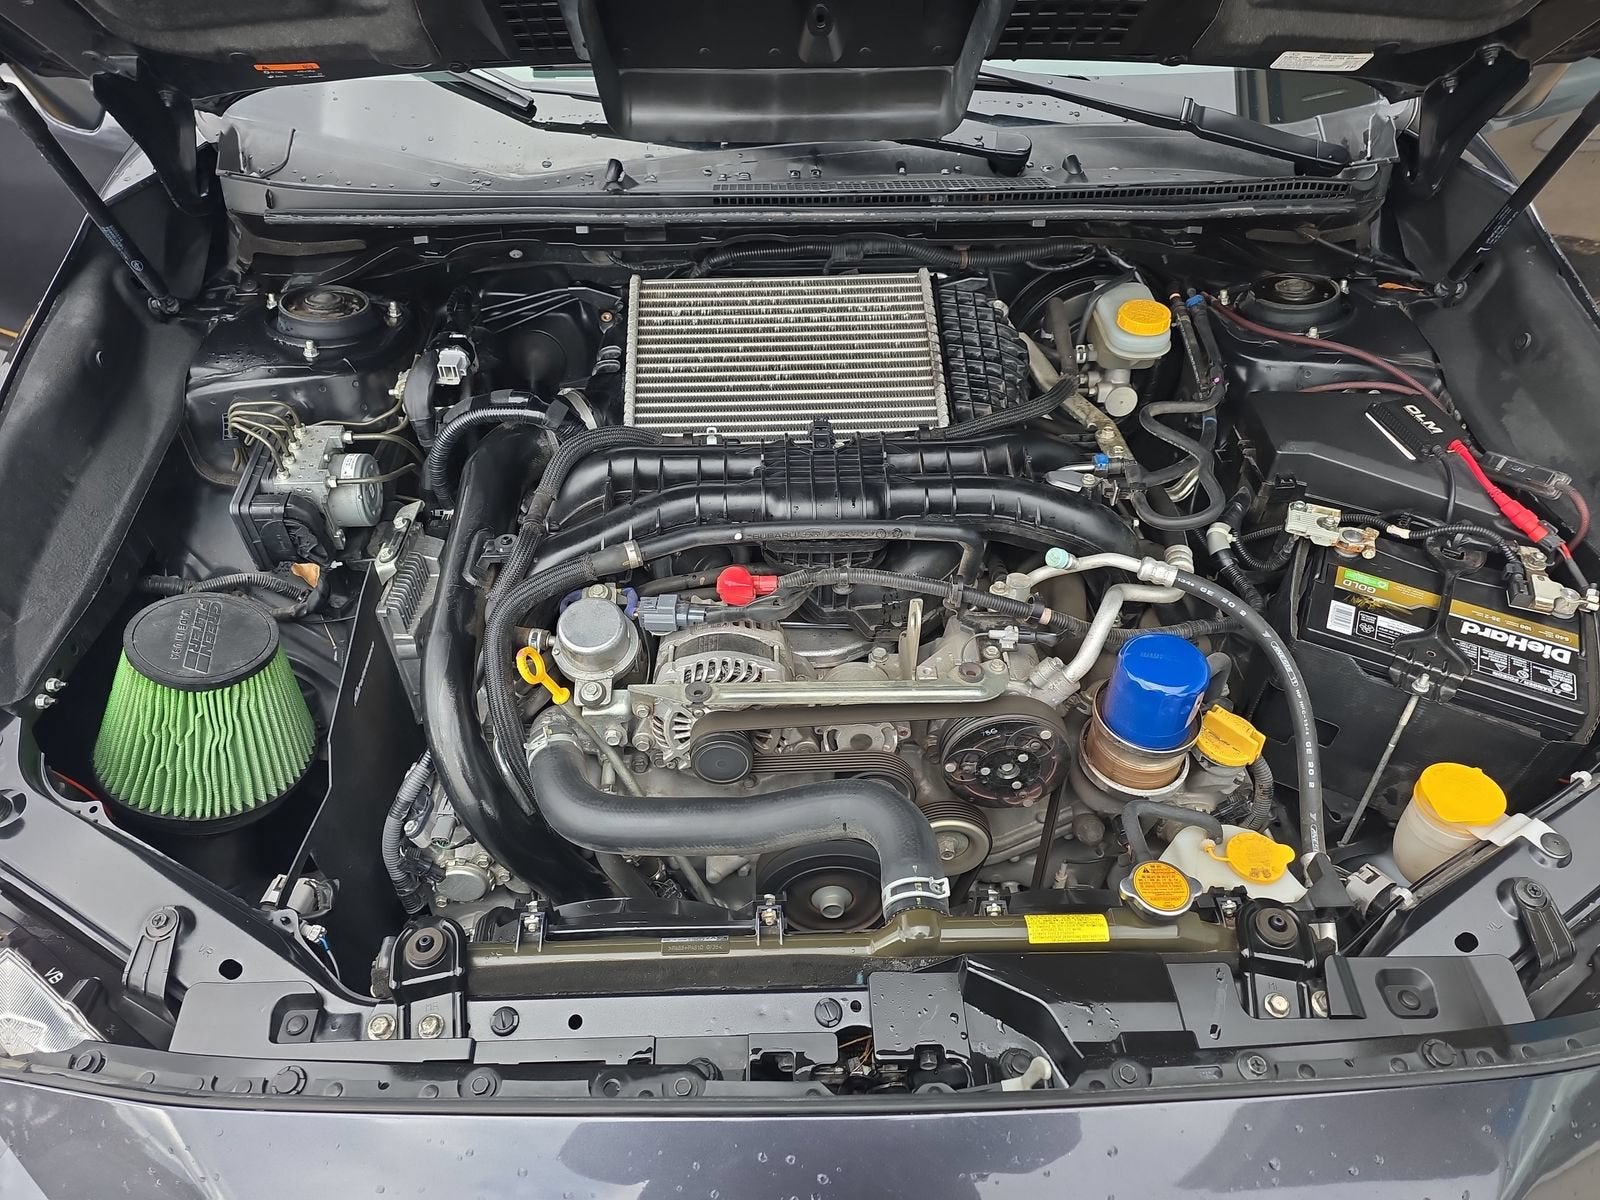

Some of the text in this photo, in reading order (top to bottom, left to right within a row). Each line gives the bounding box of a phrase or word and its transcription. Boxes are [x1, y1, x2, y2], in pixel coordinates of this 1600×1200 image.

[1404, 404, 1443, 433] OLM
[1342, 579, 1376, 594] GOLD
[1221, 597, 1236, 608] 20
[188, 599, 212, 653] FILTER
[200, 600, 223, 656] GREEN
[1460, 620, 1572, 664] DieHard
[1491, 670, 1519, 682] POISON
[1523, 680, 1553, 692] DANGER
